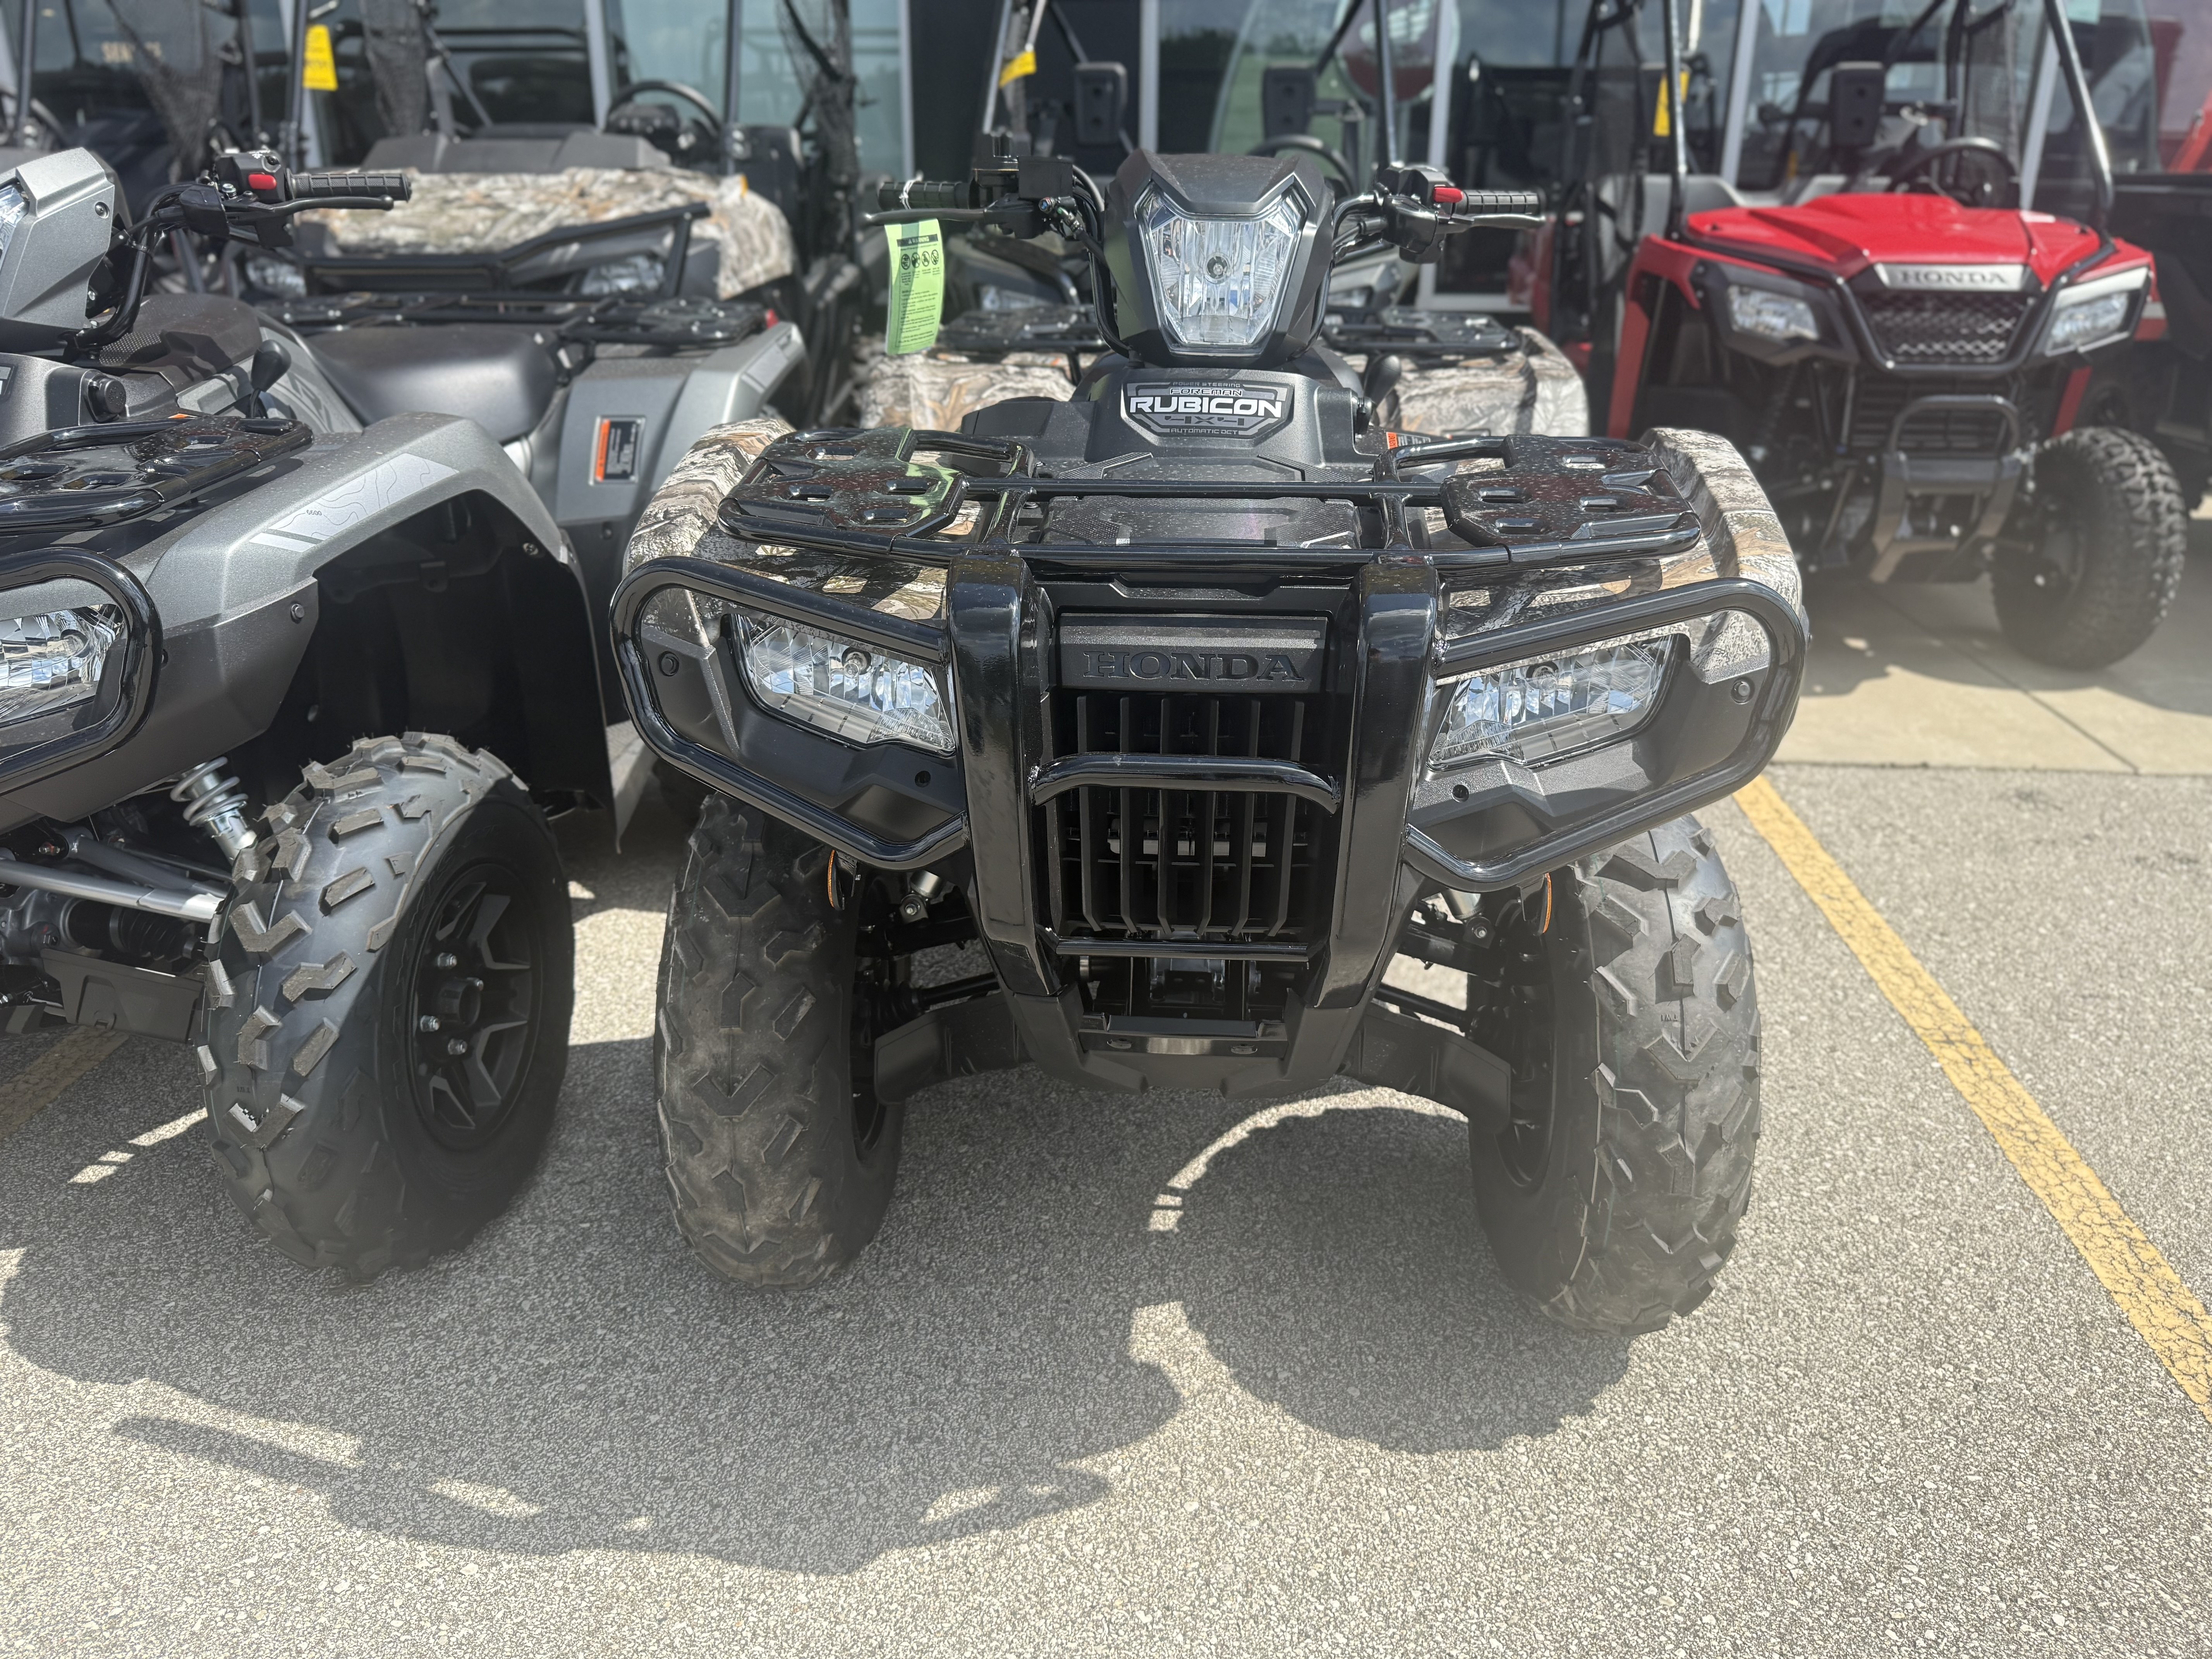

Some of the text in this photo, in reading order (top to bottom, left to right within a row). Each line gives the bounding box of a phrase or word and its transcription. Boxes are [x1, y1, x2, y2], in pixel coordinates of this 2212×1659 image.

[1899, 271, 2009, 285] HONDA
[1170, 388, 1243, 397] FOREMAN
[1130, 397, 1282, 417] RUBICON
[1083, 651, 1305, 681] HONDA
